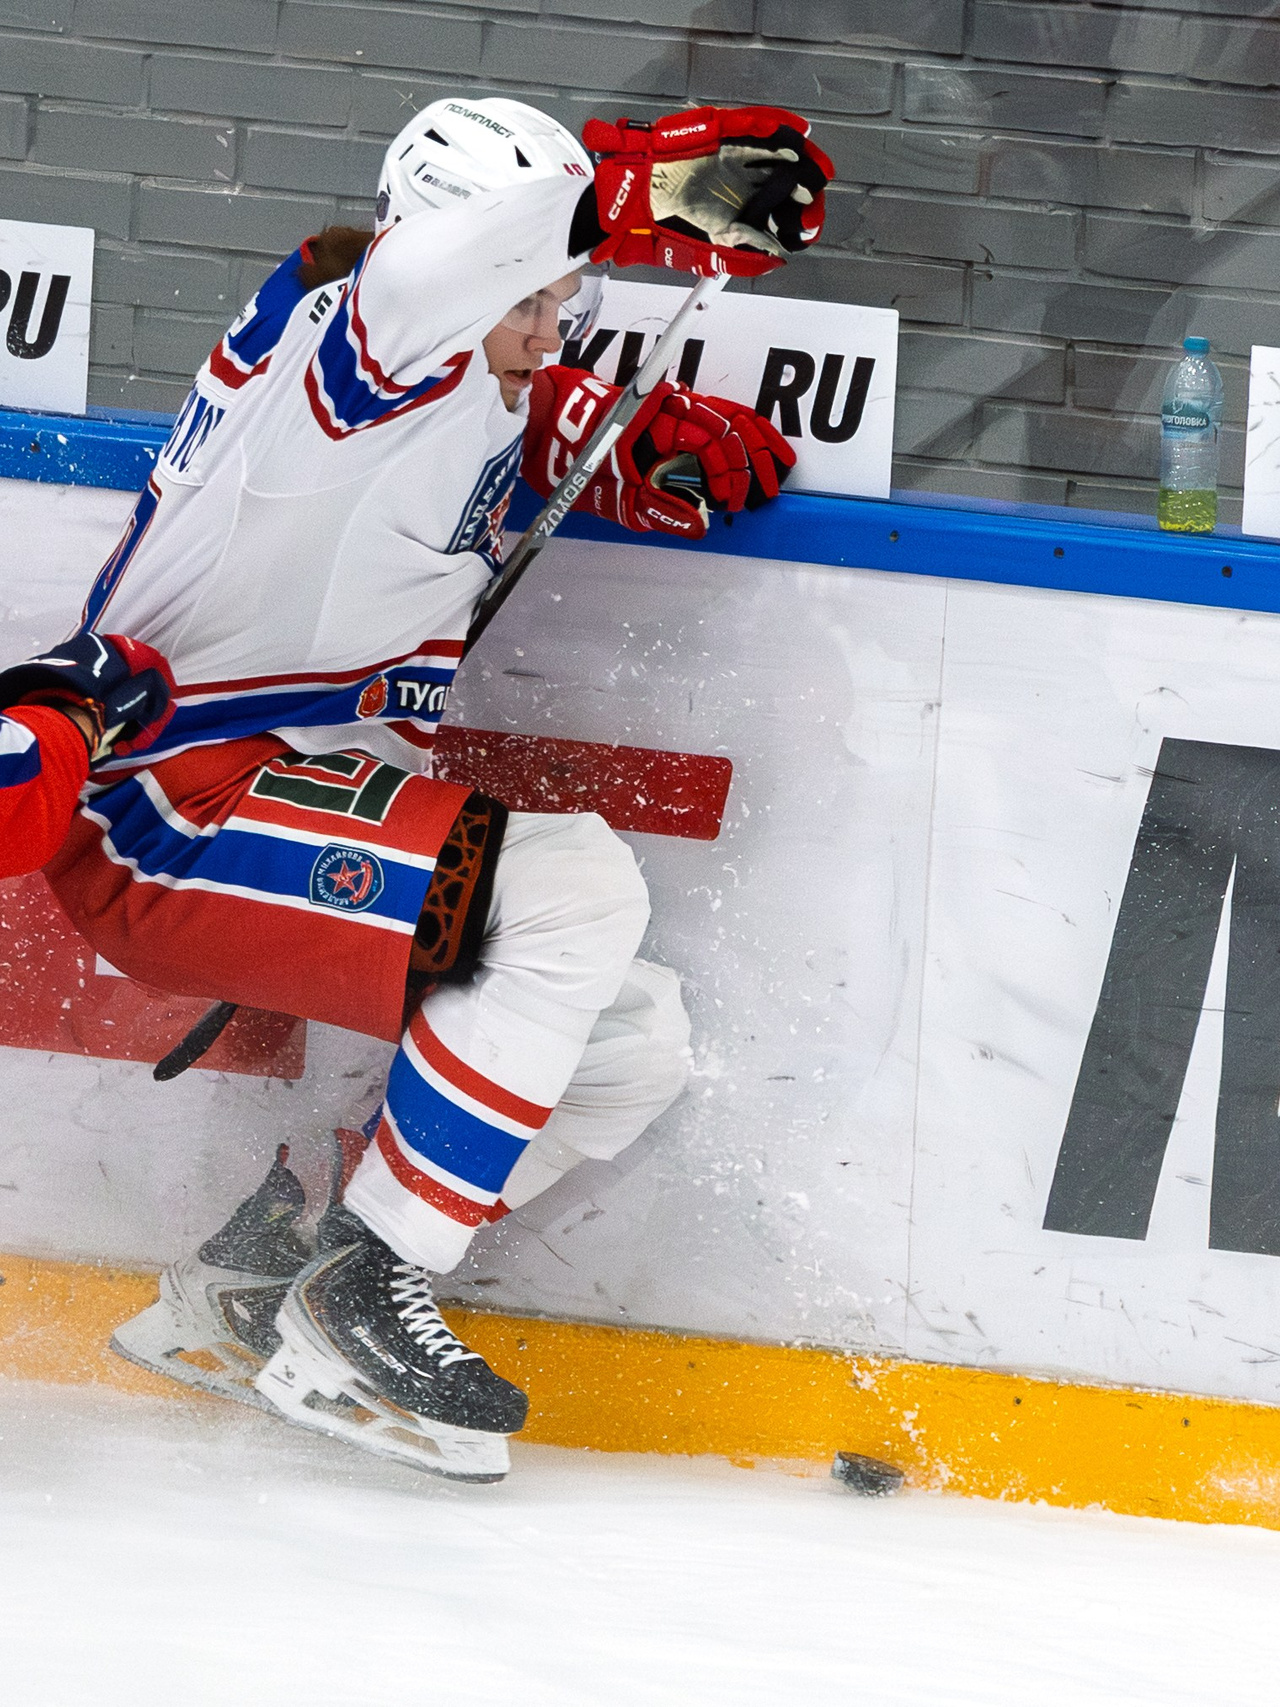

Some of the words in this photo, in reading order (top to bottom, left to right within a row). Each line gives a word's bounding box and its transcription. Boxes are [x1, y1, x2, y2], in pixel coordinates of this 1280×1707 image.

[661, 124, 708, 139] TACKS
[607, 168, 636, 221] CCM
[646, 507, 692, 530] CCM
[397, 681, 450, 712] ТУЛ
